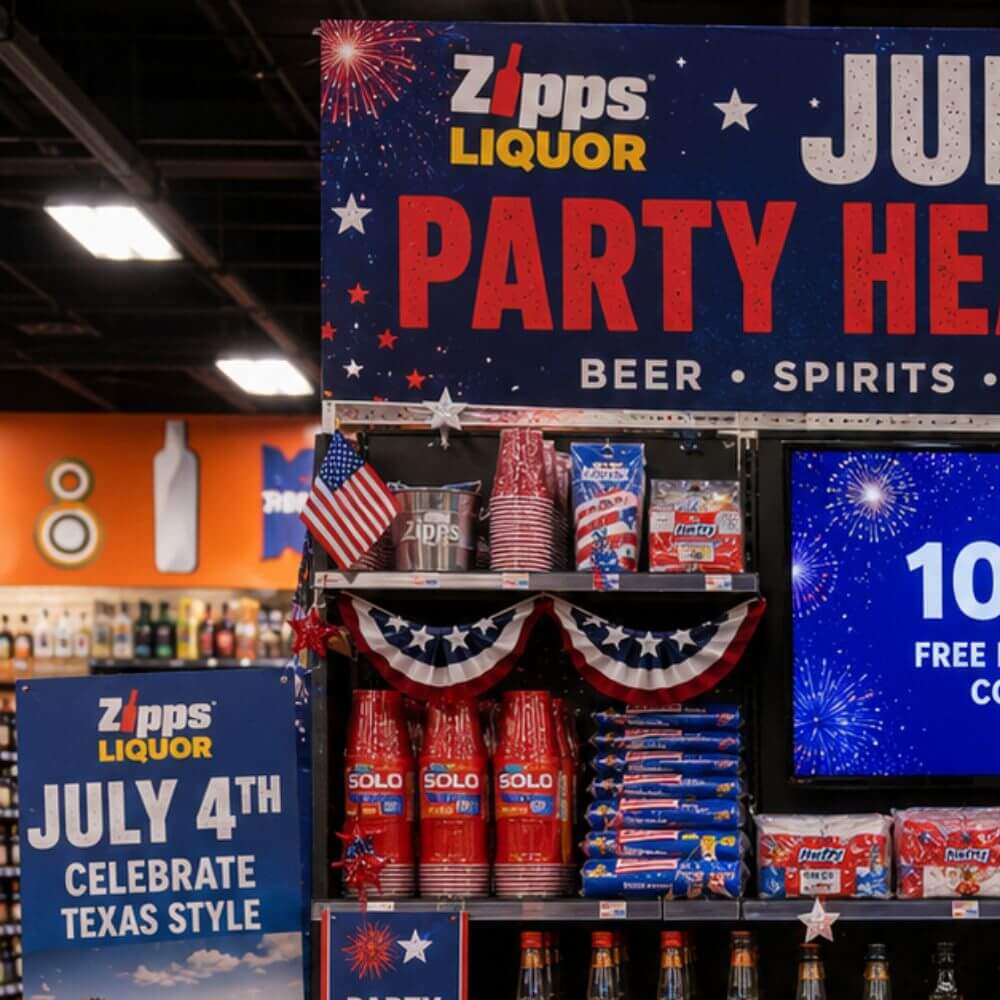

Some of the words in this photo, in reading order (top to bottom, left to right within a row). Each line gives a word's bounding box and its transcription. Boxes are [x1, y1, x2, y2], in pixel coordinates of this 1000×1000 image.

[450, 43, 648, 130] Zipps
[450, 128, 647, 171] LIQUOR
[398, 195, 797, 333] PARTY
[580, 358, 702, 391] BEER
[773, 361, 955, 393] SPIRITS
[915, 641, 986, 668] FREE
[98, 688, 214, 738] Zipps
[98, 736, 213, 763] LIQUOR
[349, 773, 403, 789] SOLO
[424, 773, 479, 789] SOLO
[499, 773, 553, 789] SOLO
[27, 779, 178, 850] JULY
[196, 775, 282, 840] 4TH
[65, 855, 256, 897] CELEBRATE
[61, 905, 159, 939] TEXAS
[168, 899, 262, 935] STYLE
